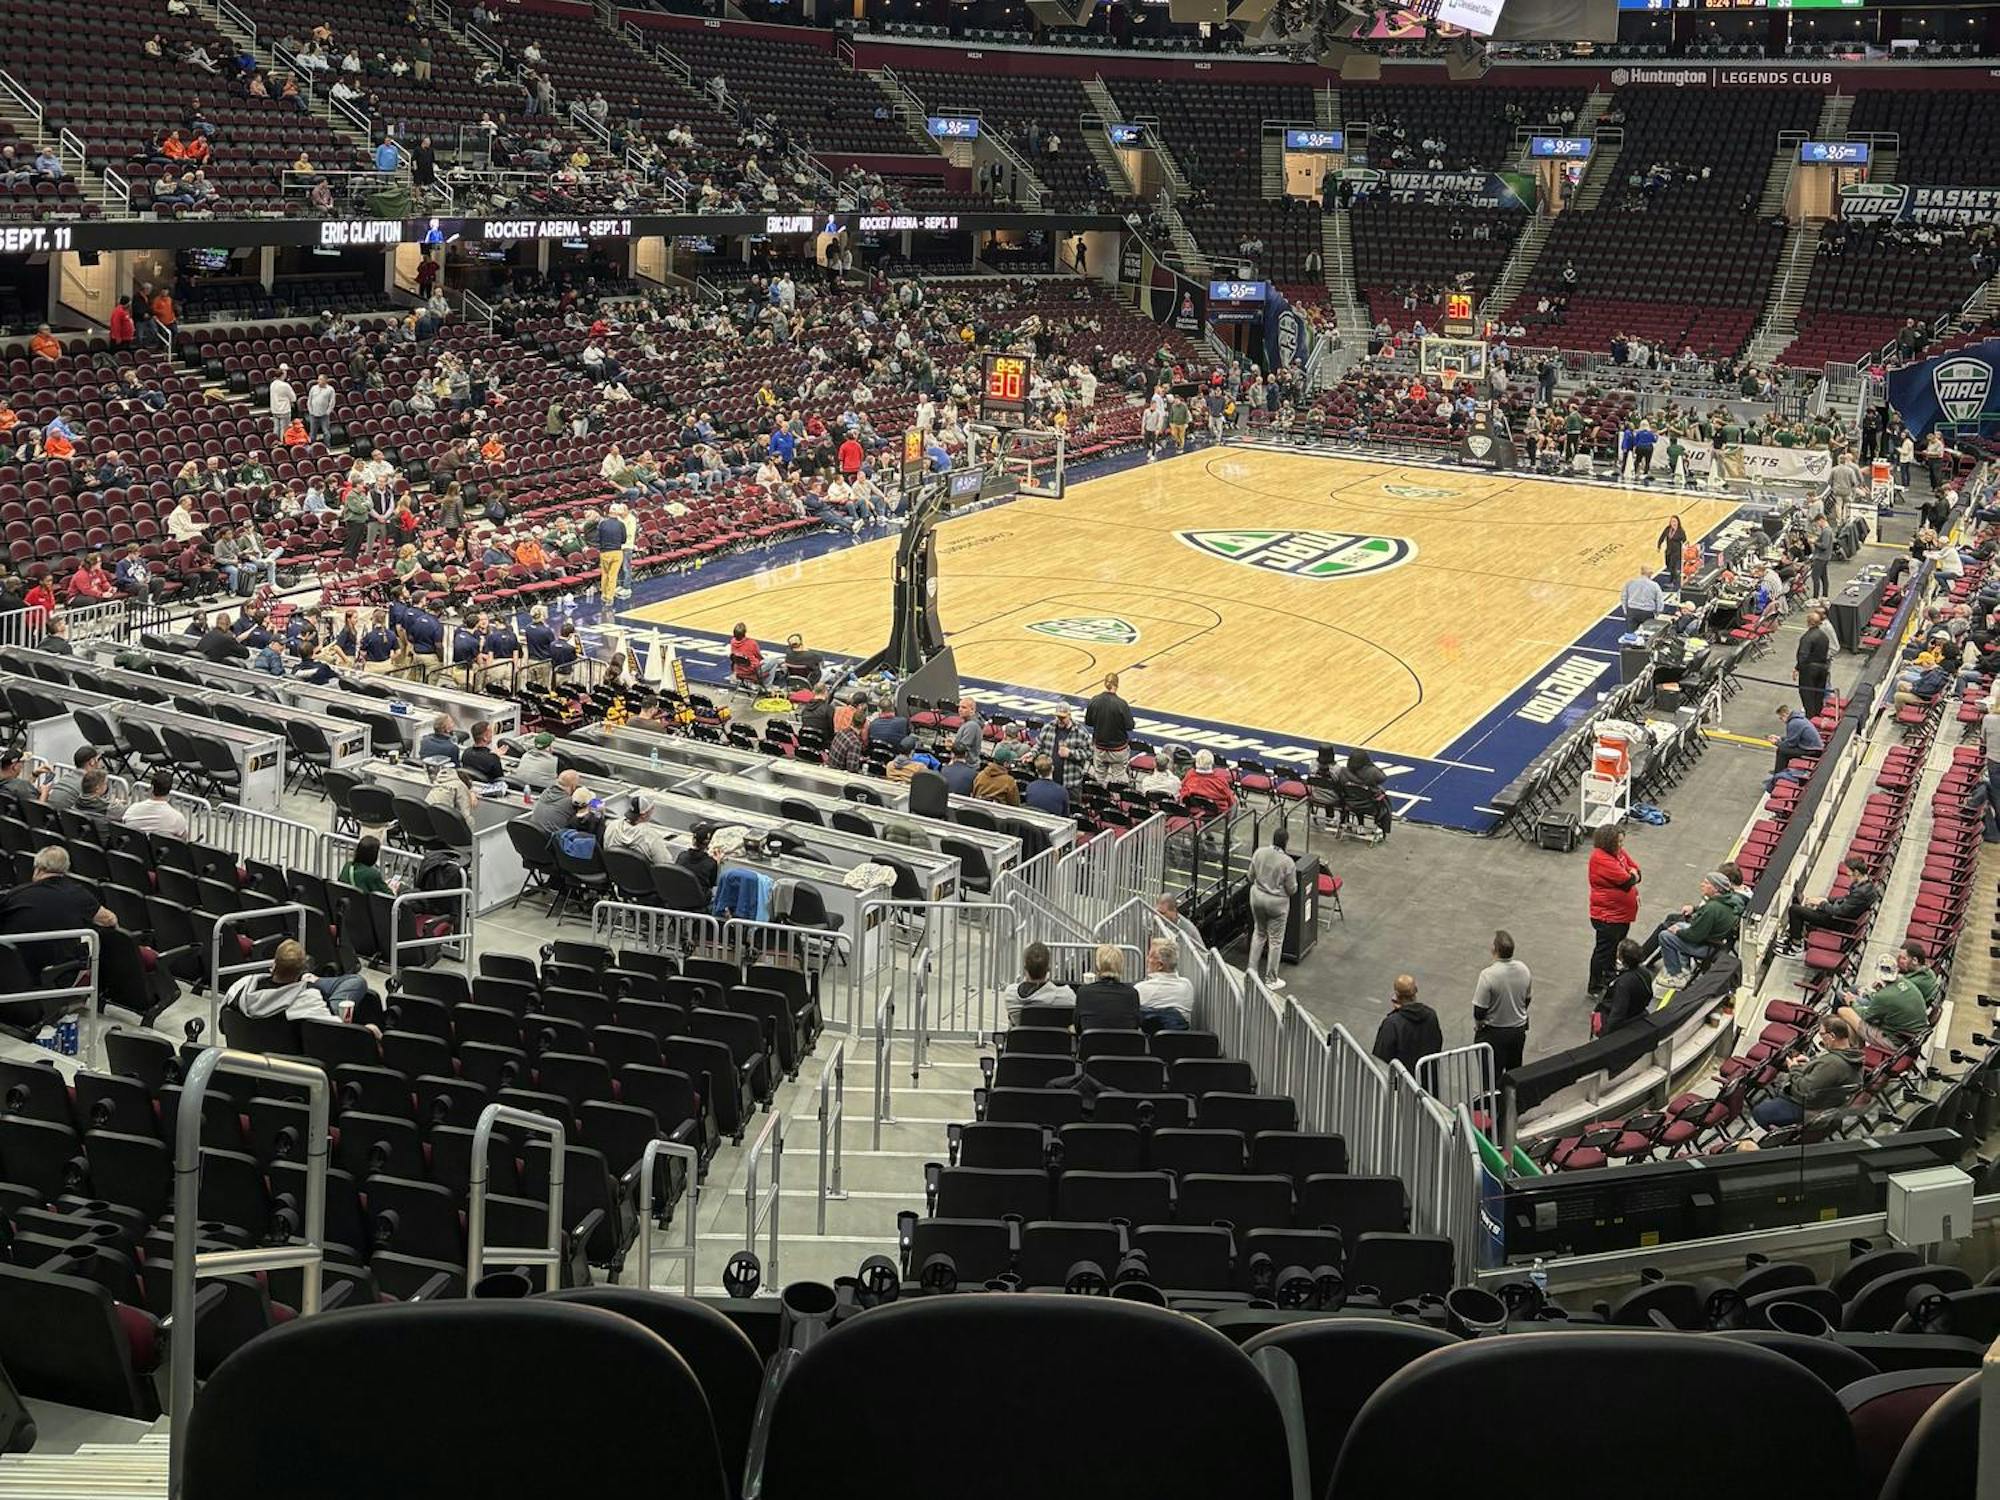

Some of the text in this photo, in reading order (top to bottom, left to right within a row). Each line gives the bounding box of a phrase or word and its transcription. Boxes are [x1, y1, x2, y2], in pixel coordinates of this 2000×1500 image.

[1631, 68, 1832, 87] Huntington LEGENDS CLUB
[1388, 173, 1487, 192] WELCOME
[1841, 199, 1903, 213] MAC
[321, 221, 402, 243] ERIC CLAPTON
[485, 221, 537, 238] ROCKET
[538, 221, 581, 237] ARENA
[589, 220, 620, 235] SEPT.
[622, 220, 631, 235] 11
[767, 216, 813, 233] ERIC CLAPTON
[859, 217, 891, 230] ROCKET
[891, 217, 919, 230] ARENA
[924, 217, 949, 229] SEPT.
[950, 217, 959, 229] 11
[0, 227, 71, 250] SEPT. 11
[1448, 302, 1469, 319] 30
[996, 357, 1024, 373] 8:24
[990, 372, 1019, 398] 30
[1940, 381, 1987, 399] MAC
[1516, 655, 1611, 724] MACTION
